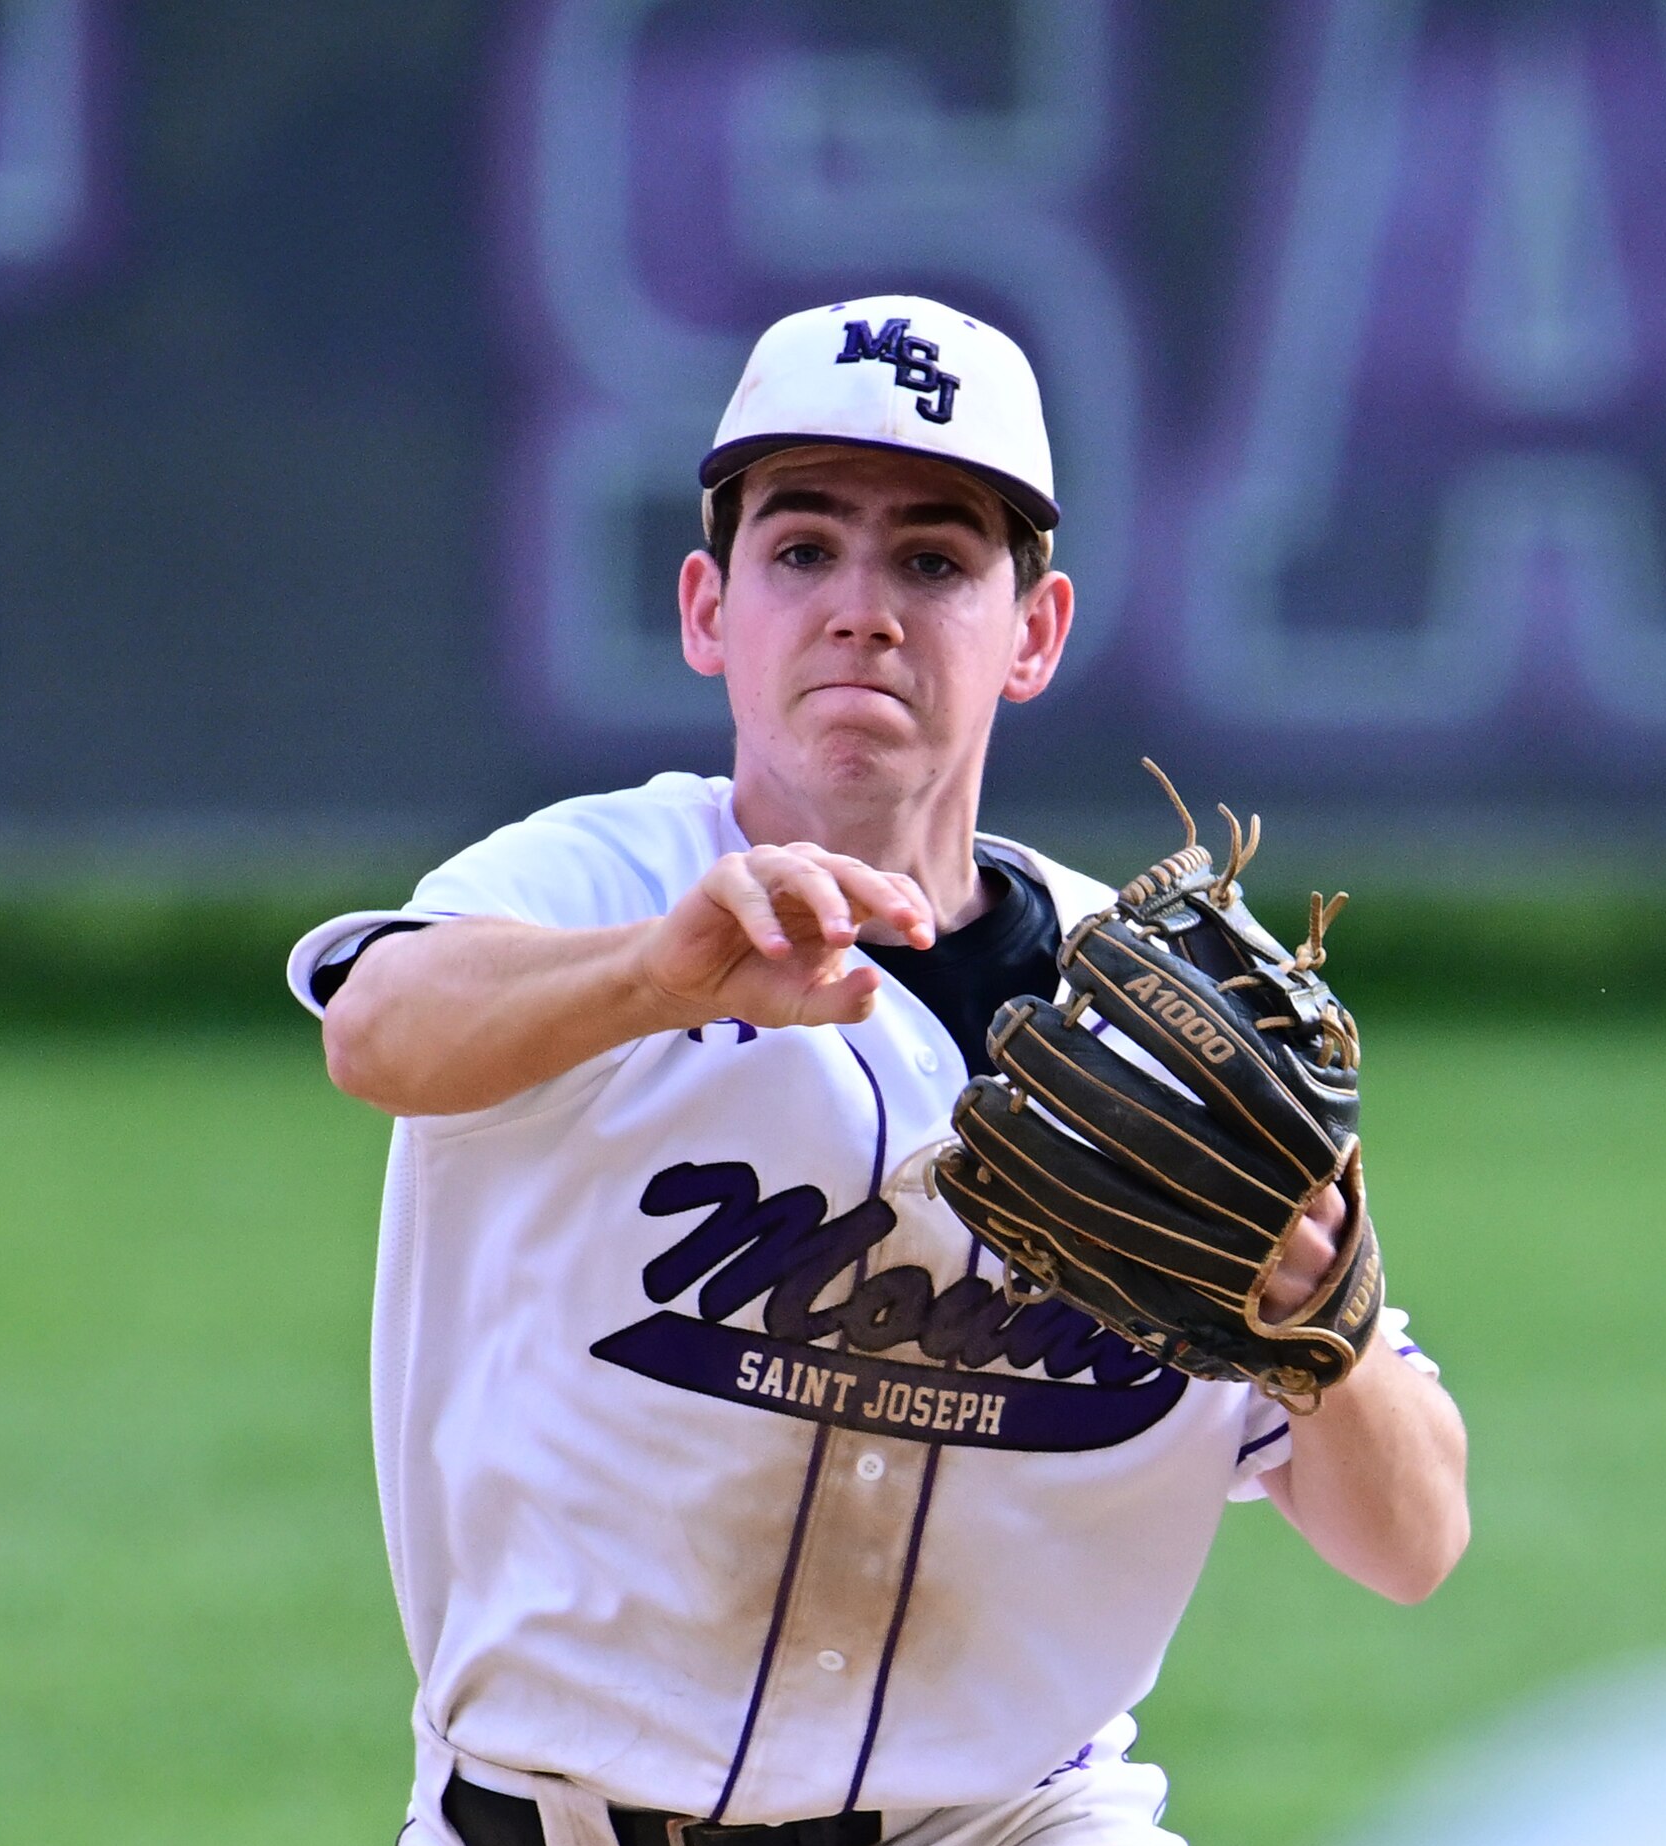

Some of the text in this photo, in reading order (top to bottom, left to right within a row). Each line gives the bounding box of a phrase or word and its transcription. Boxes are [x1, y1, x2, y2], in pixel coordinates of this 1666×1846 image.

[835, 318, 961, 425] MSJ
[1123, 973, 1236, 1065] A1000
[735, 1350, 1006, 1436] SAINT JOSEPH
